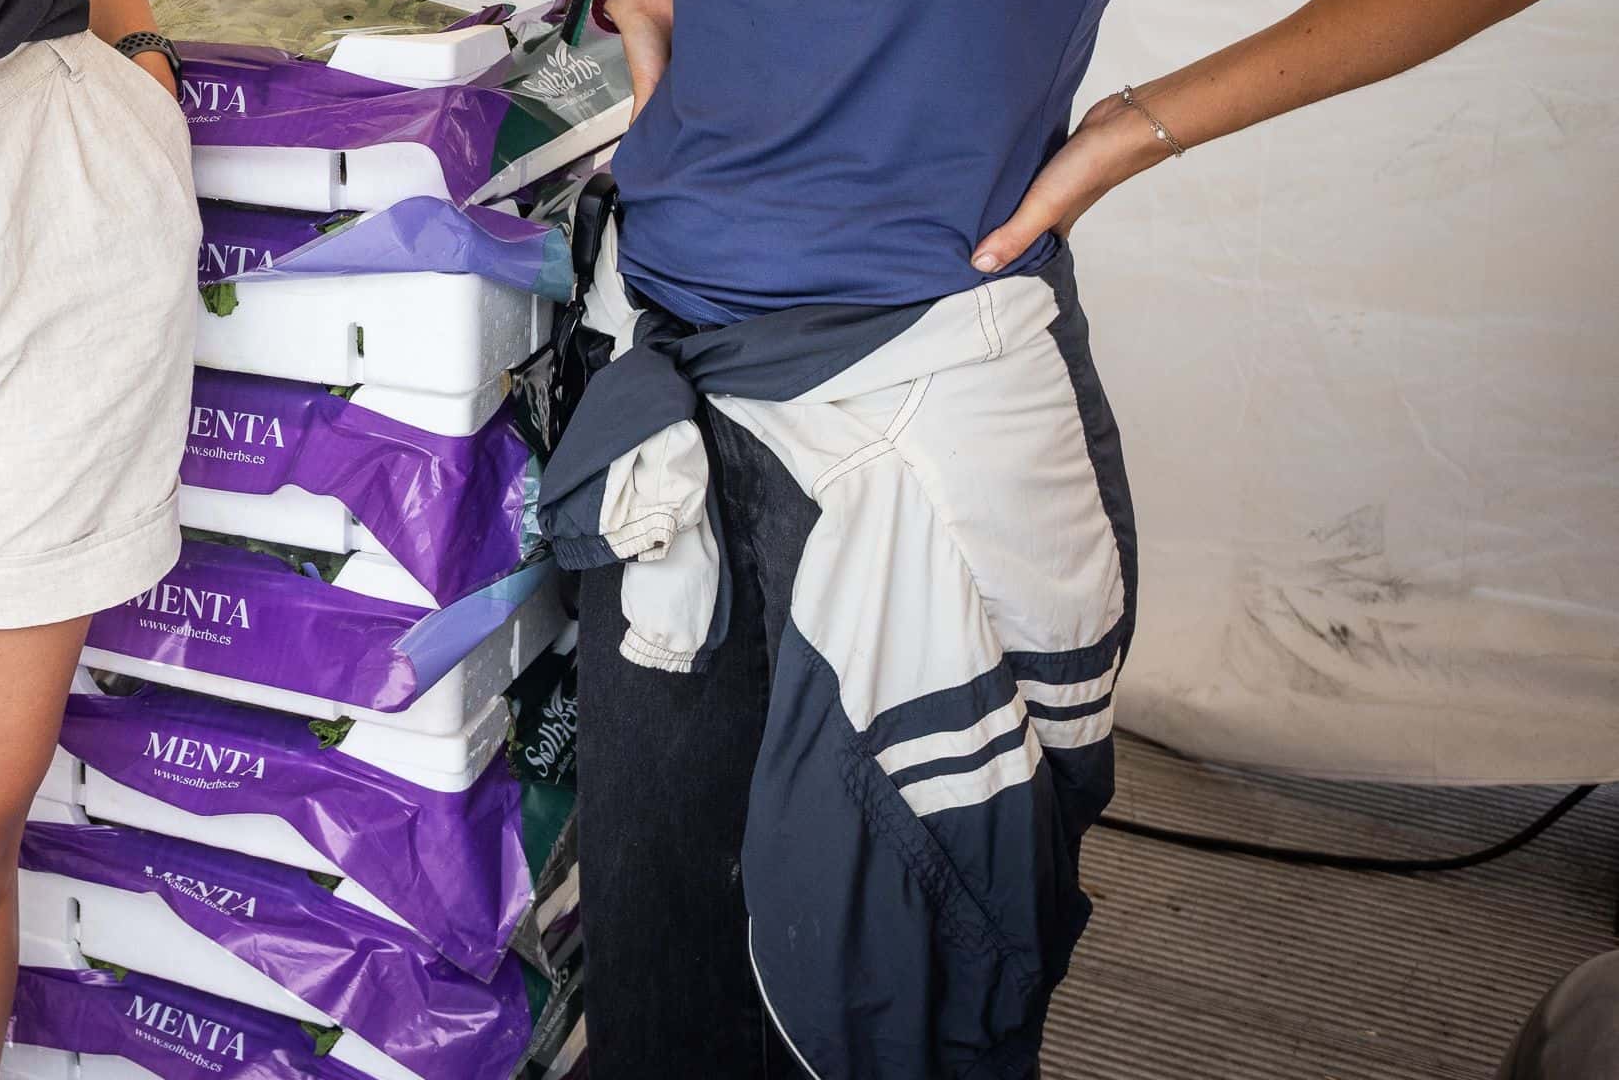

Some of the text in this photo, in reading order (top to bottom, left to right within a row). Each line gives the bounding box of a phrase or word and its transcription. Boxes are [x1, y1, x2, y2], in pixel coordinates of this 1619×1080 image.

[180, 79, 246, 113] NTA
[198, 241, 273, 275] NTA
[190, 406, 285, 448] ENTA
[139, 618, 232, 646] www.solherbs.es
[142, 731, 265, 780] MENTA
[153, 768, 240, 790] www.solherbs.es
[125, 994, 245, 1062] MENTA
[135, 1028, 223, 1073] www.solherbs.es
